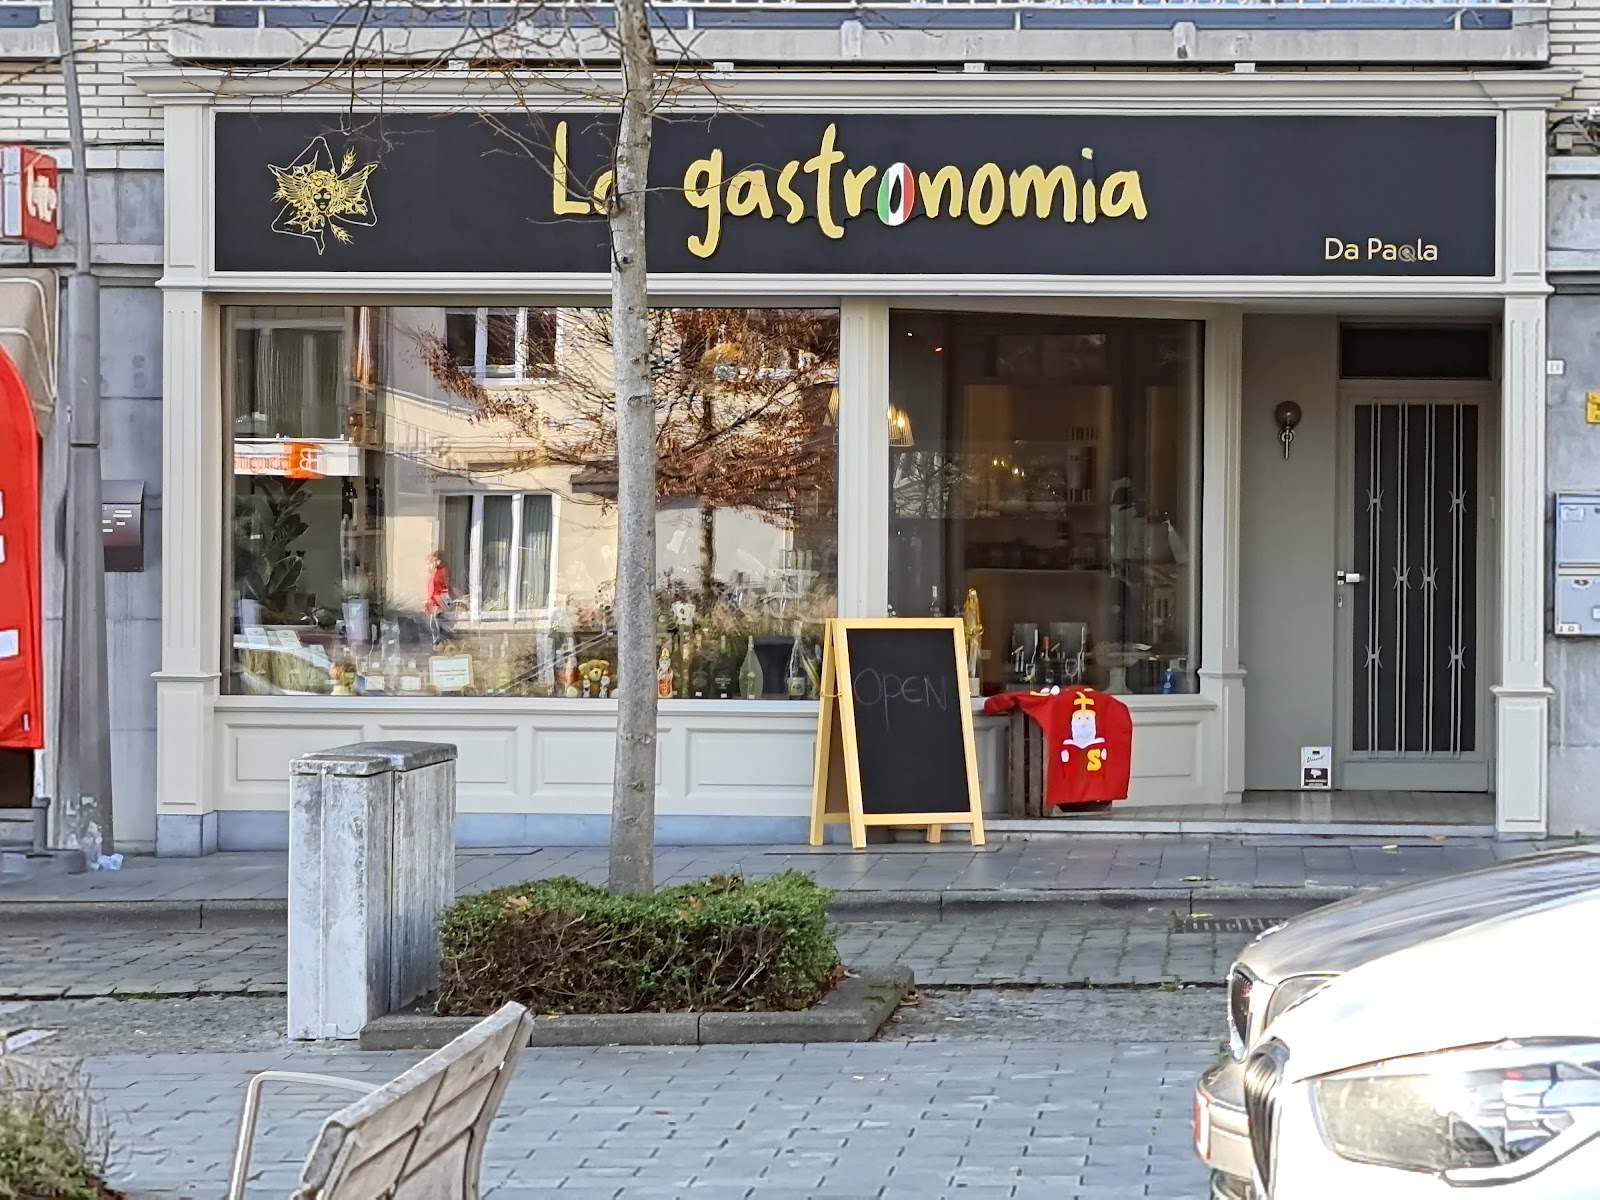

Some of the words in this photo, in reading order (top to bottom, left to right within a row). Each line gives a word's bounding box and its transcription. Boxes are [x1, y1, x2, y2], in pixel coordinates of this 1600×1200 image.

[683, 123, 1148, 259] gastronomia
[1325, 237, 1359, 260] Da
[1367, 237, 1438, 262] Paola
[853, 667, 947, 731] OPEN
[1087, 748, 1102, 772] S
